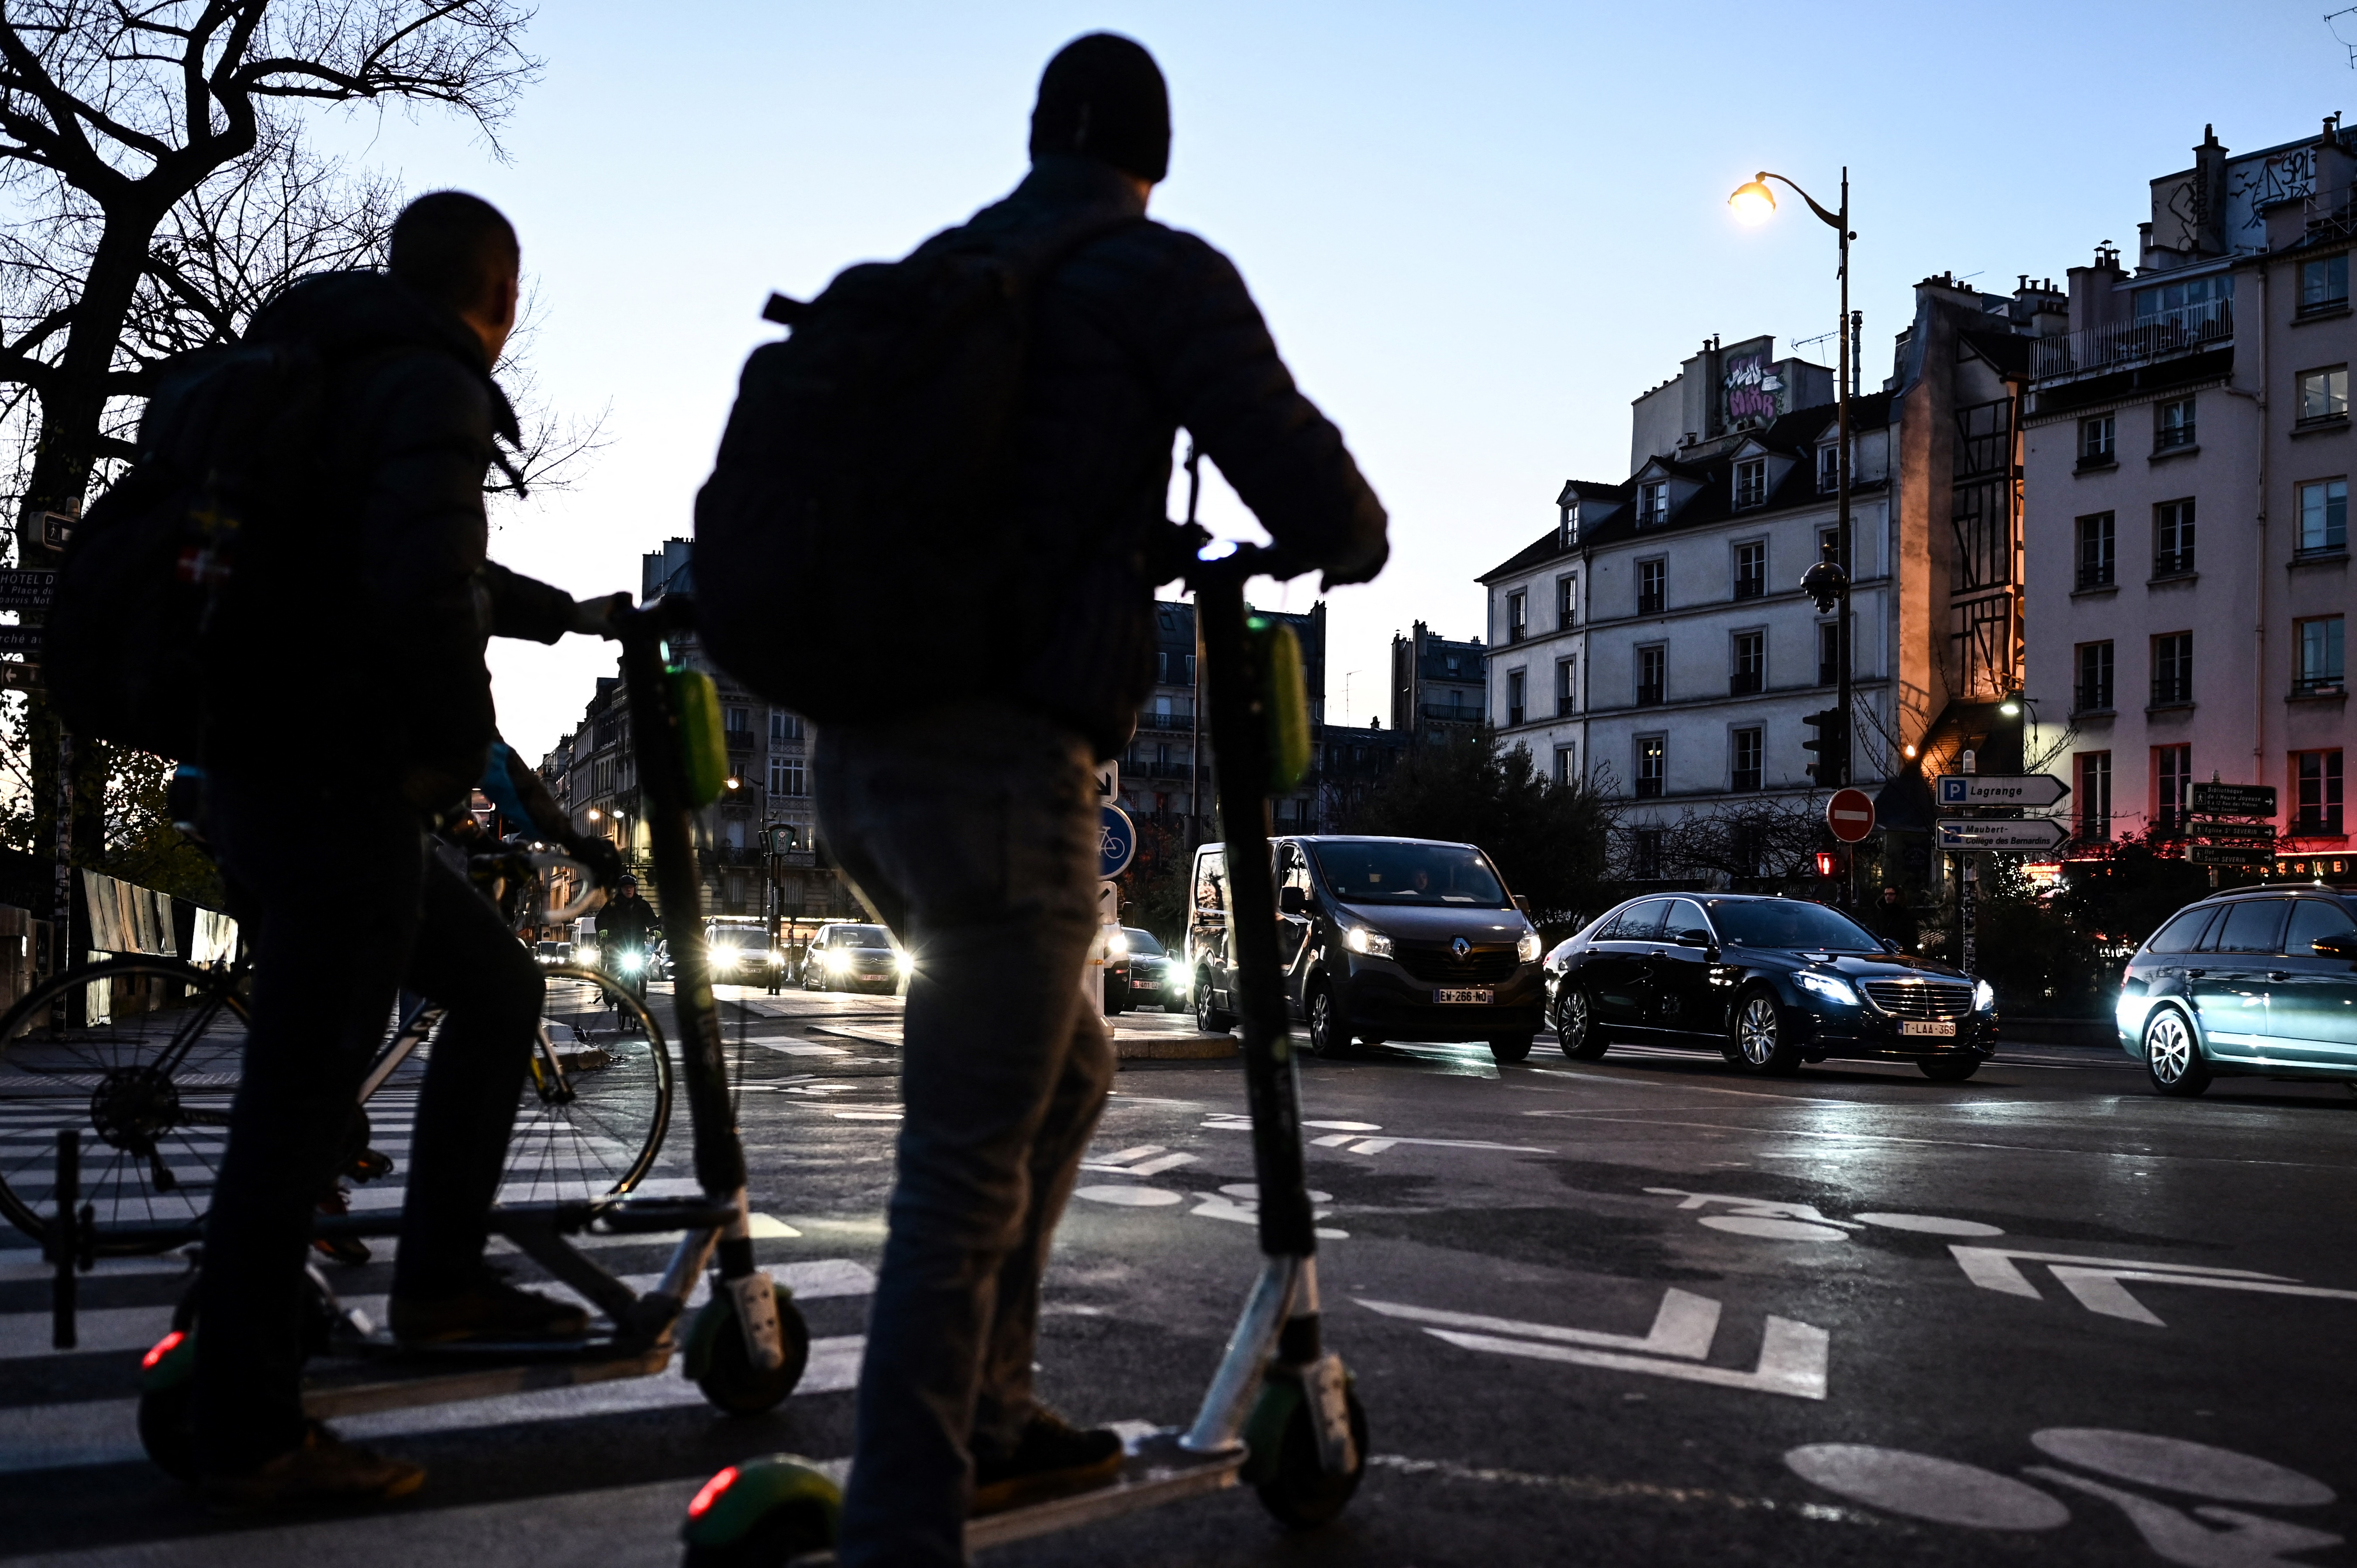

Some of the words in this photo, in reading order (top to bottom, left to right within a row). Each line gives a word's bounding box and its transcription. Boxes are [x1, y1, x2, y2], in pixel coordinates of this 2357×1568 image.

[0, 572, 39, 584] HÔTEL
[45, 575, 55, 584] D
[11, 586, 38, 594] Place
[1950, 784, 1961, 797] P
[1971, 786, 2022, 797] Lagrange
[1966, 837, 1994, 846] Collège
[1904, 1024, 1955, 1034] T-LAA-369
